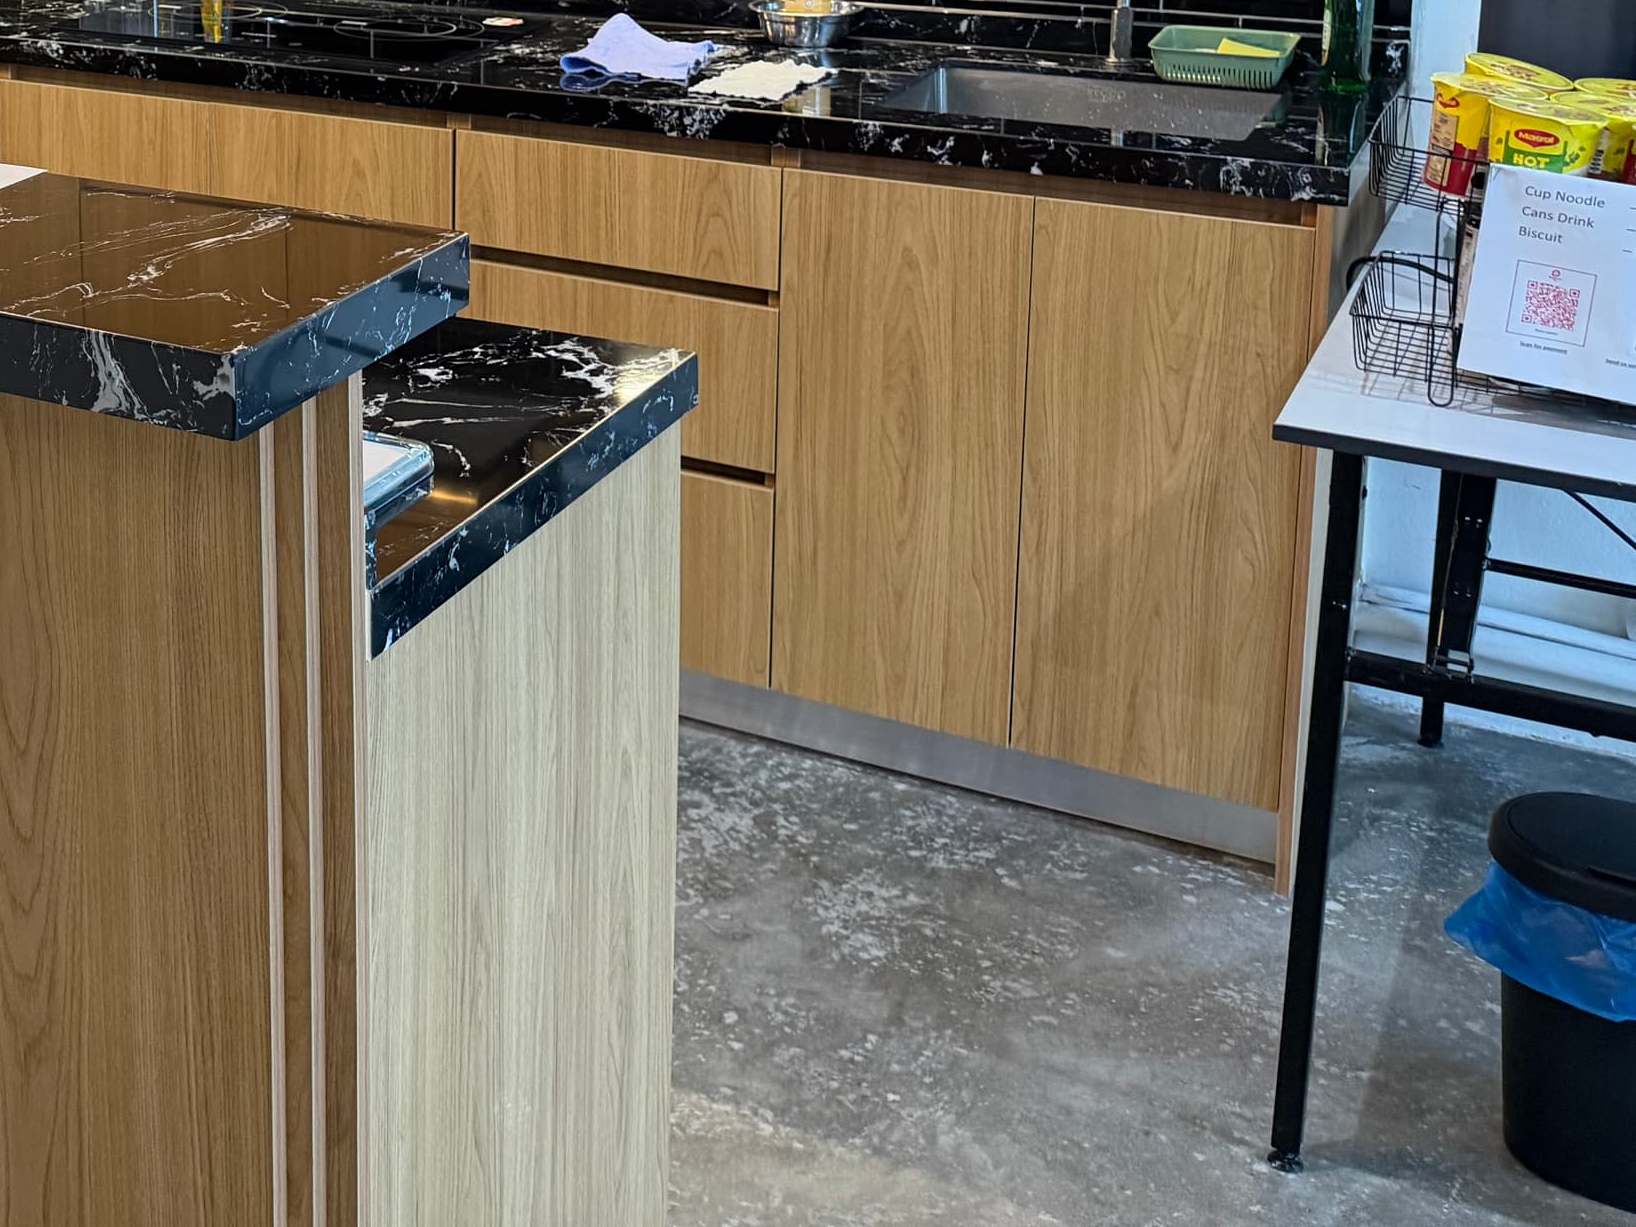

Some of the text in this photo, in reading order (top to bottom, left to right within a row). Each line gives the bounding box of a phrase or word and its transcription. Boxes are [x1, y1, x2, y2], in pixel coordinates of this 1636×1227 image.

[1513, 153, 1550, 168] HOT
[1525, 185, 1605, 208] Cup Noodle
[1522, 205, 1595, 229] Cans Drink
[1518, 226, 1563, 244] Biscuit
